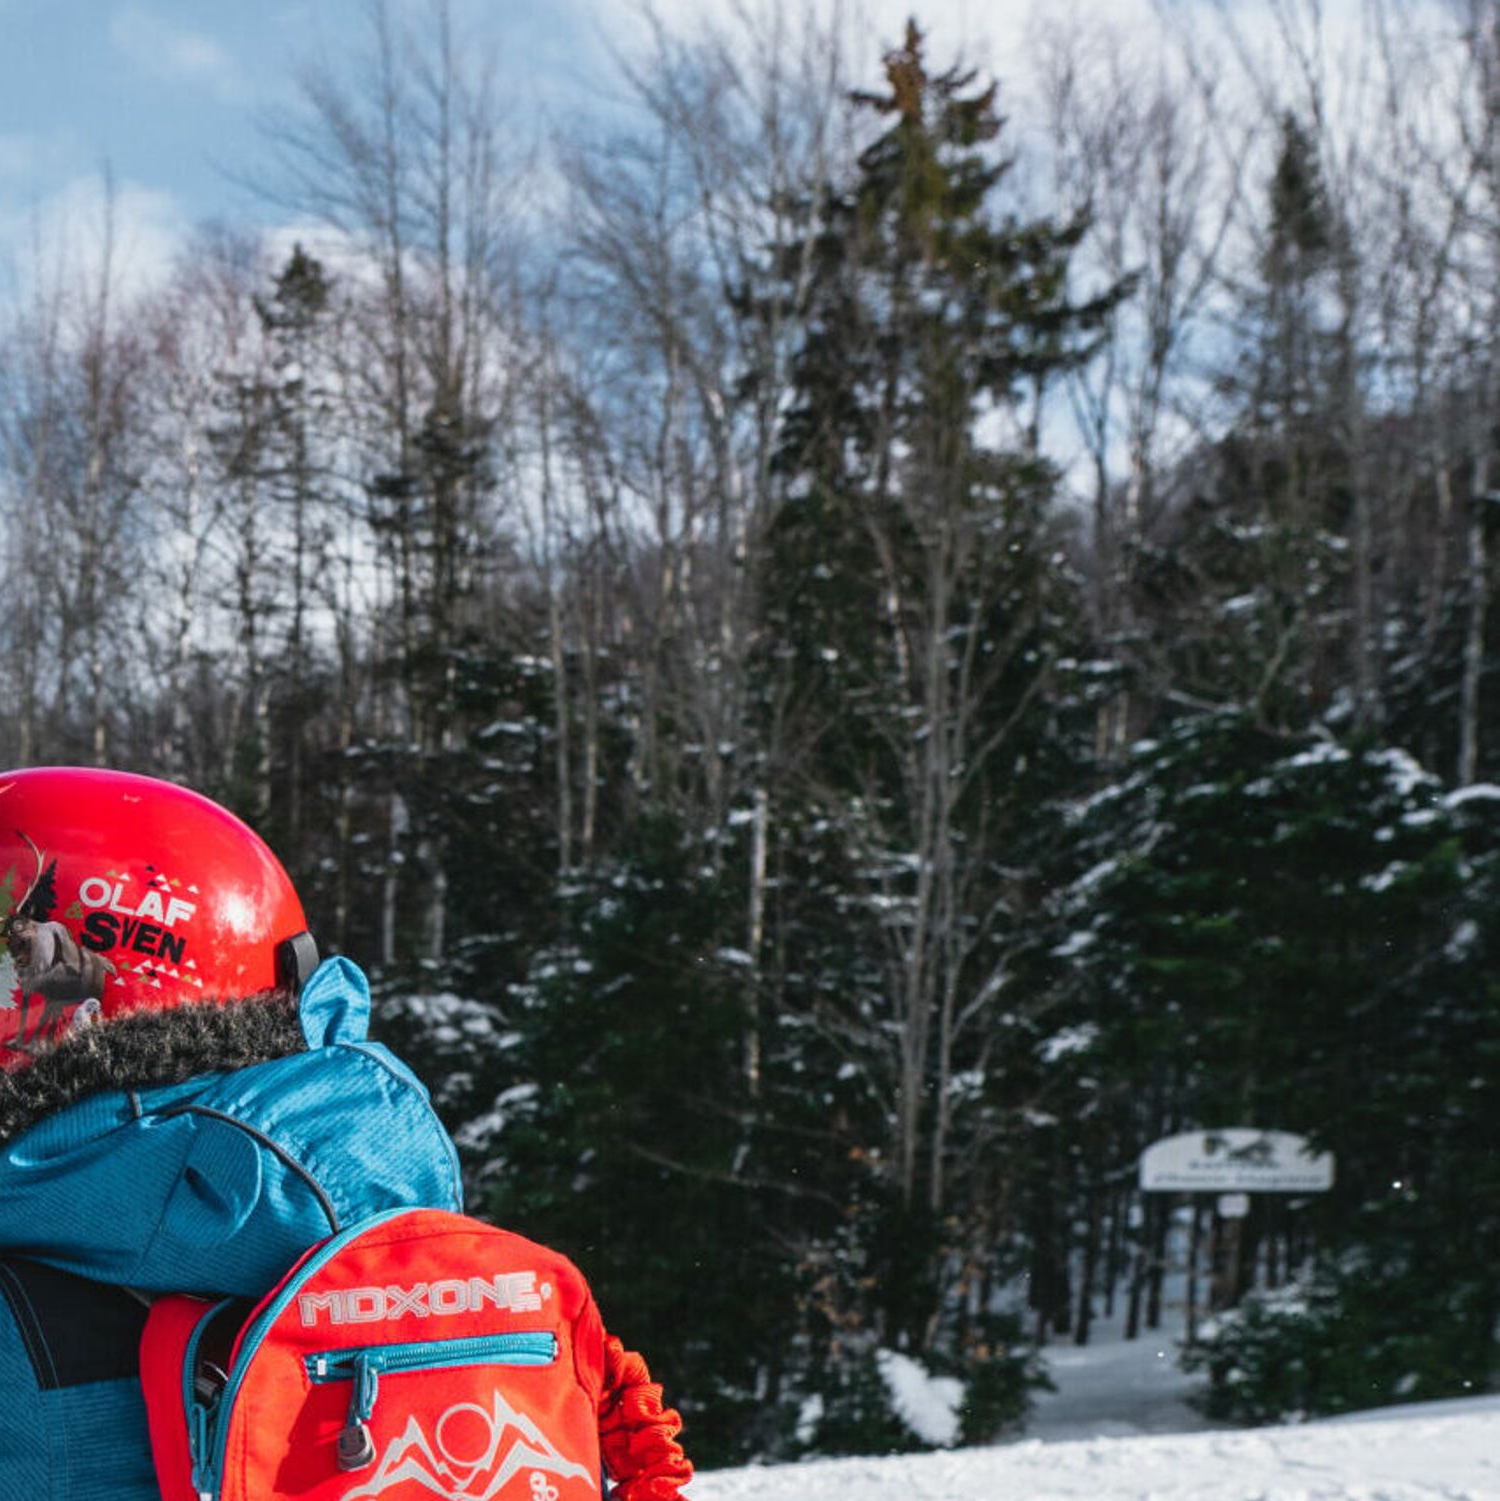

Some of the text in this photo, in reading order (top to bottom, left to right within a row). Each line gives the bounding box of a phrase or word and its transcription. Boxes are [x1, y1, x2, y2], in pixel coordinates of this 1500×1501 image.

[80, 878, 196, 927] OLAF
[80, 912, 186, 964] SVEN
[299, 1271, 542, 1325] MDXONE
